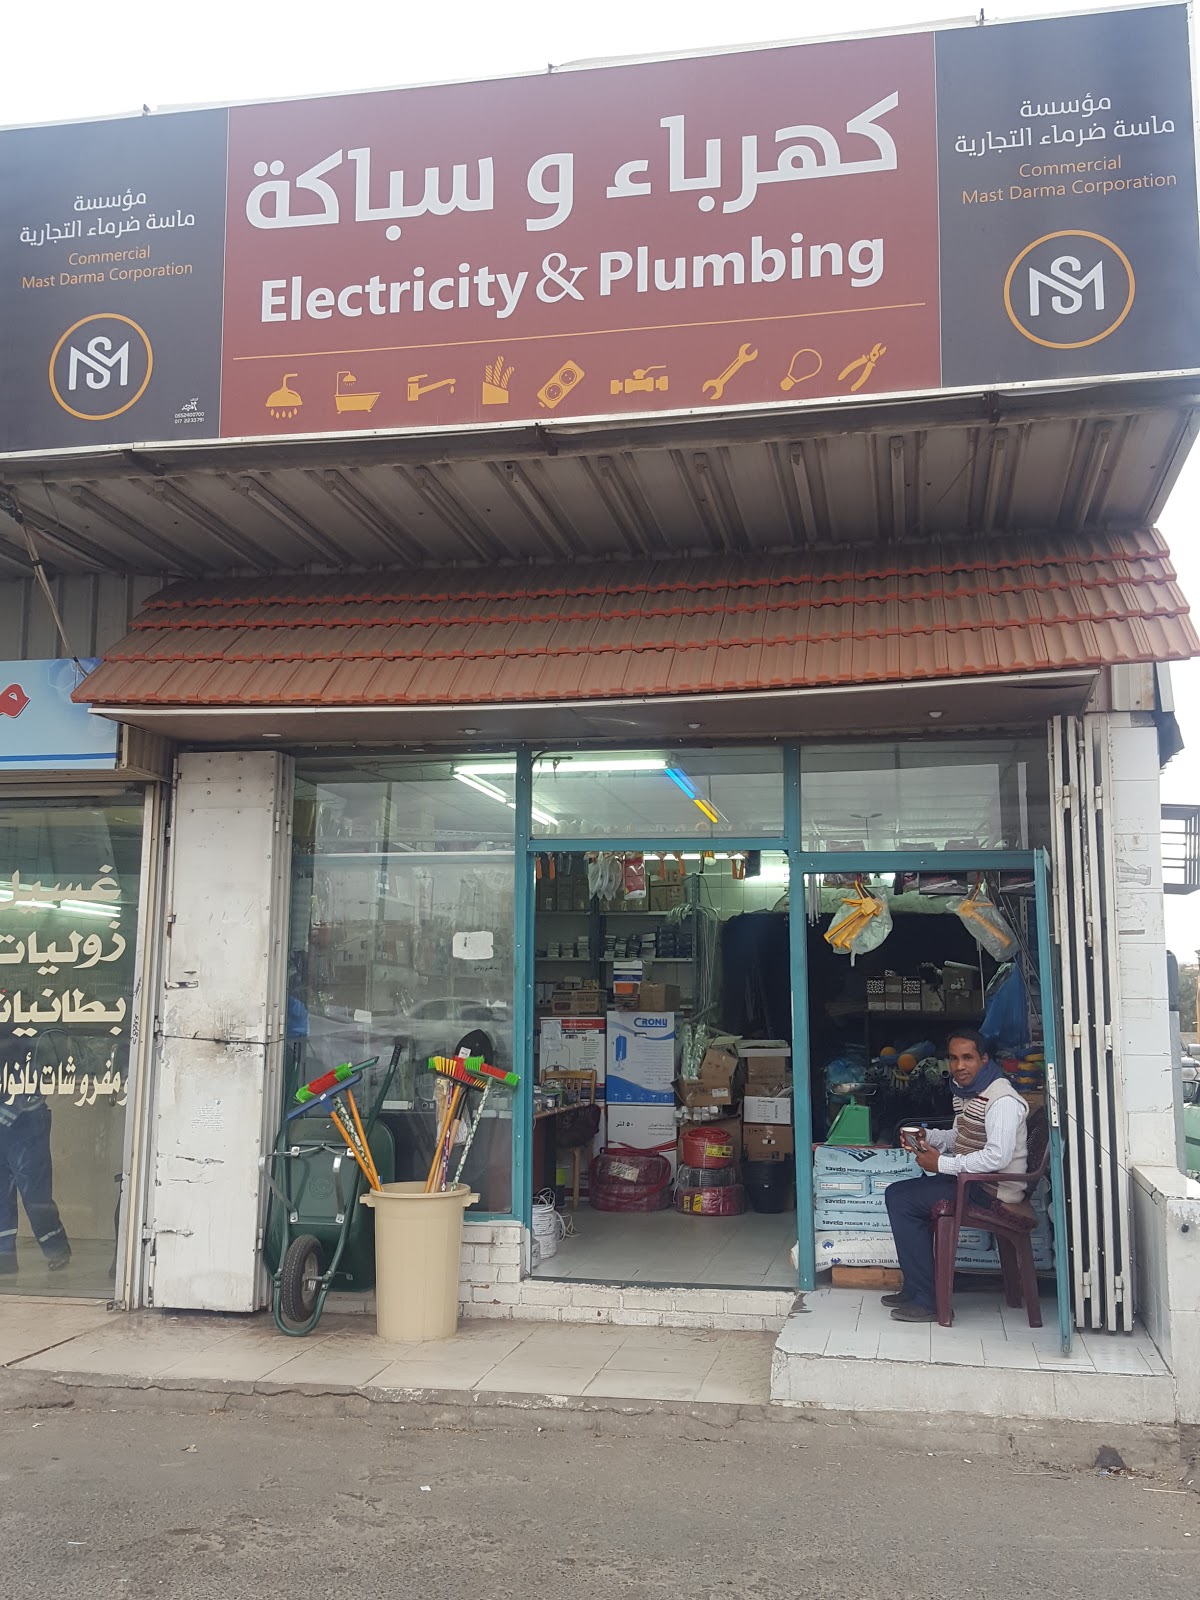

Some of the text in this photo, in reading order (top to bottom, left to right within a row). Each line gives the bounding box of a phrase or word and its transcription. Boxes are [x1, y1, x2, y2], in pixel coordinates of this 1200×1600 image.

[1020, 92, 1112, 118] مؤسسة
[954, 115, 1175, 157] ماسة ضرماء التجارية
[246, 90, 899, 241] كهرباء و سباكة
[1019, 155, 1122, 178] Commercial
[73, 188, 147, 212] مؤسسة
[962, 173, 1177, 205] Mast Darma Corporation
[19, 210, 195, 247] ماسة ضرماء التجارية
[68, 245, 151, 266] Commercial
[22, 262, 193, 289] Mast Darma Corporation
[261, 232, 884, 323] Electricity & Plumbing
